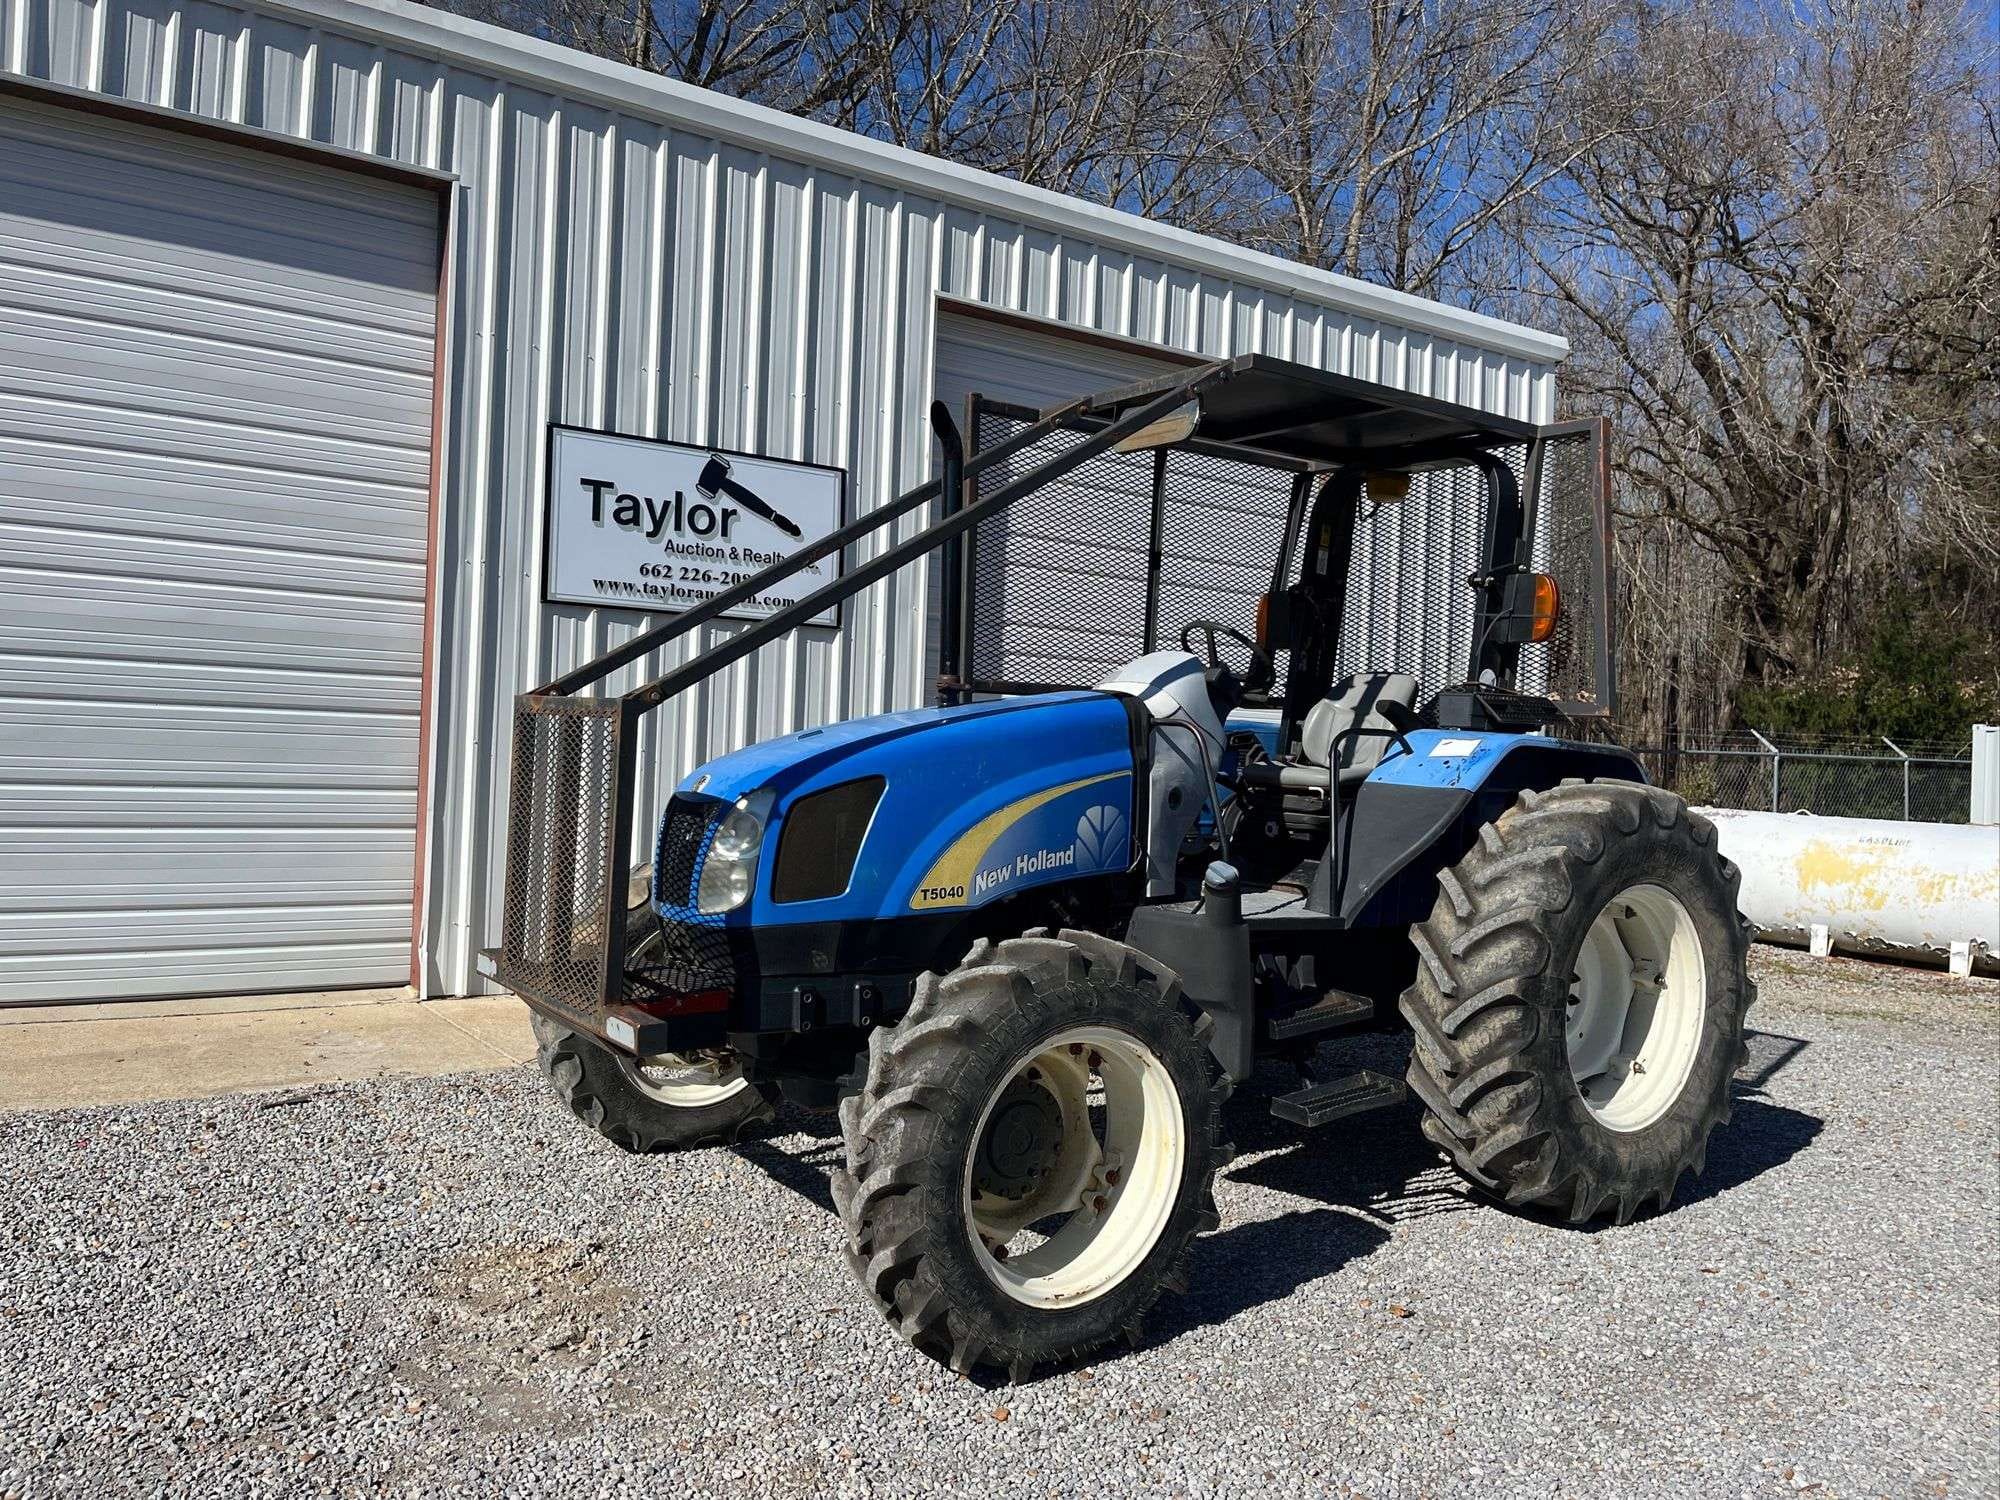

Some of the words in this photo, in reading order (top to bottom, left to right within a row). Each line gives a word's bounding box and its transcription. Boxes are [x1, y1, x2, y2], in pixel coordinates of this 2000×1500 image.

[580, 477, 738, 538] Taylor
[664, 538, 725, 559] Auction
[728, 546, 740, 561] &
[743, 548, 785, 564] Realt
[639, 562, 673, 579] 662
[975, 863, 1012, 896] New
[1016, 845, 1074, 877] Holland
[920, 885, 964, 901] T5040
